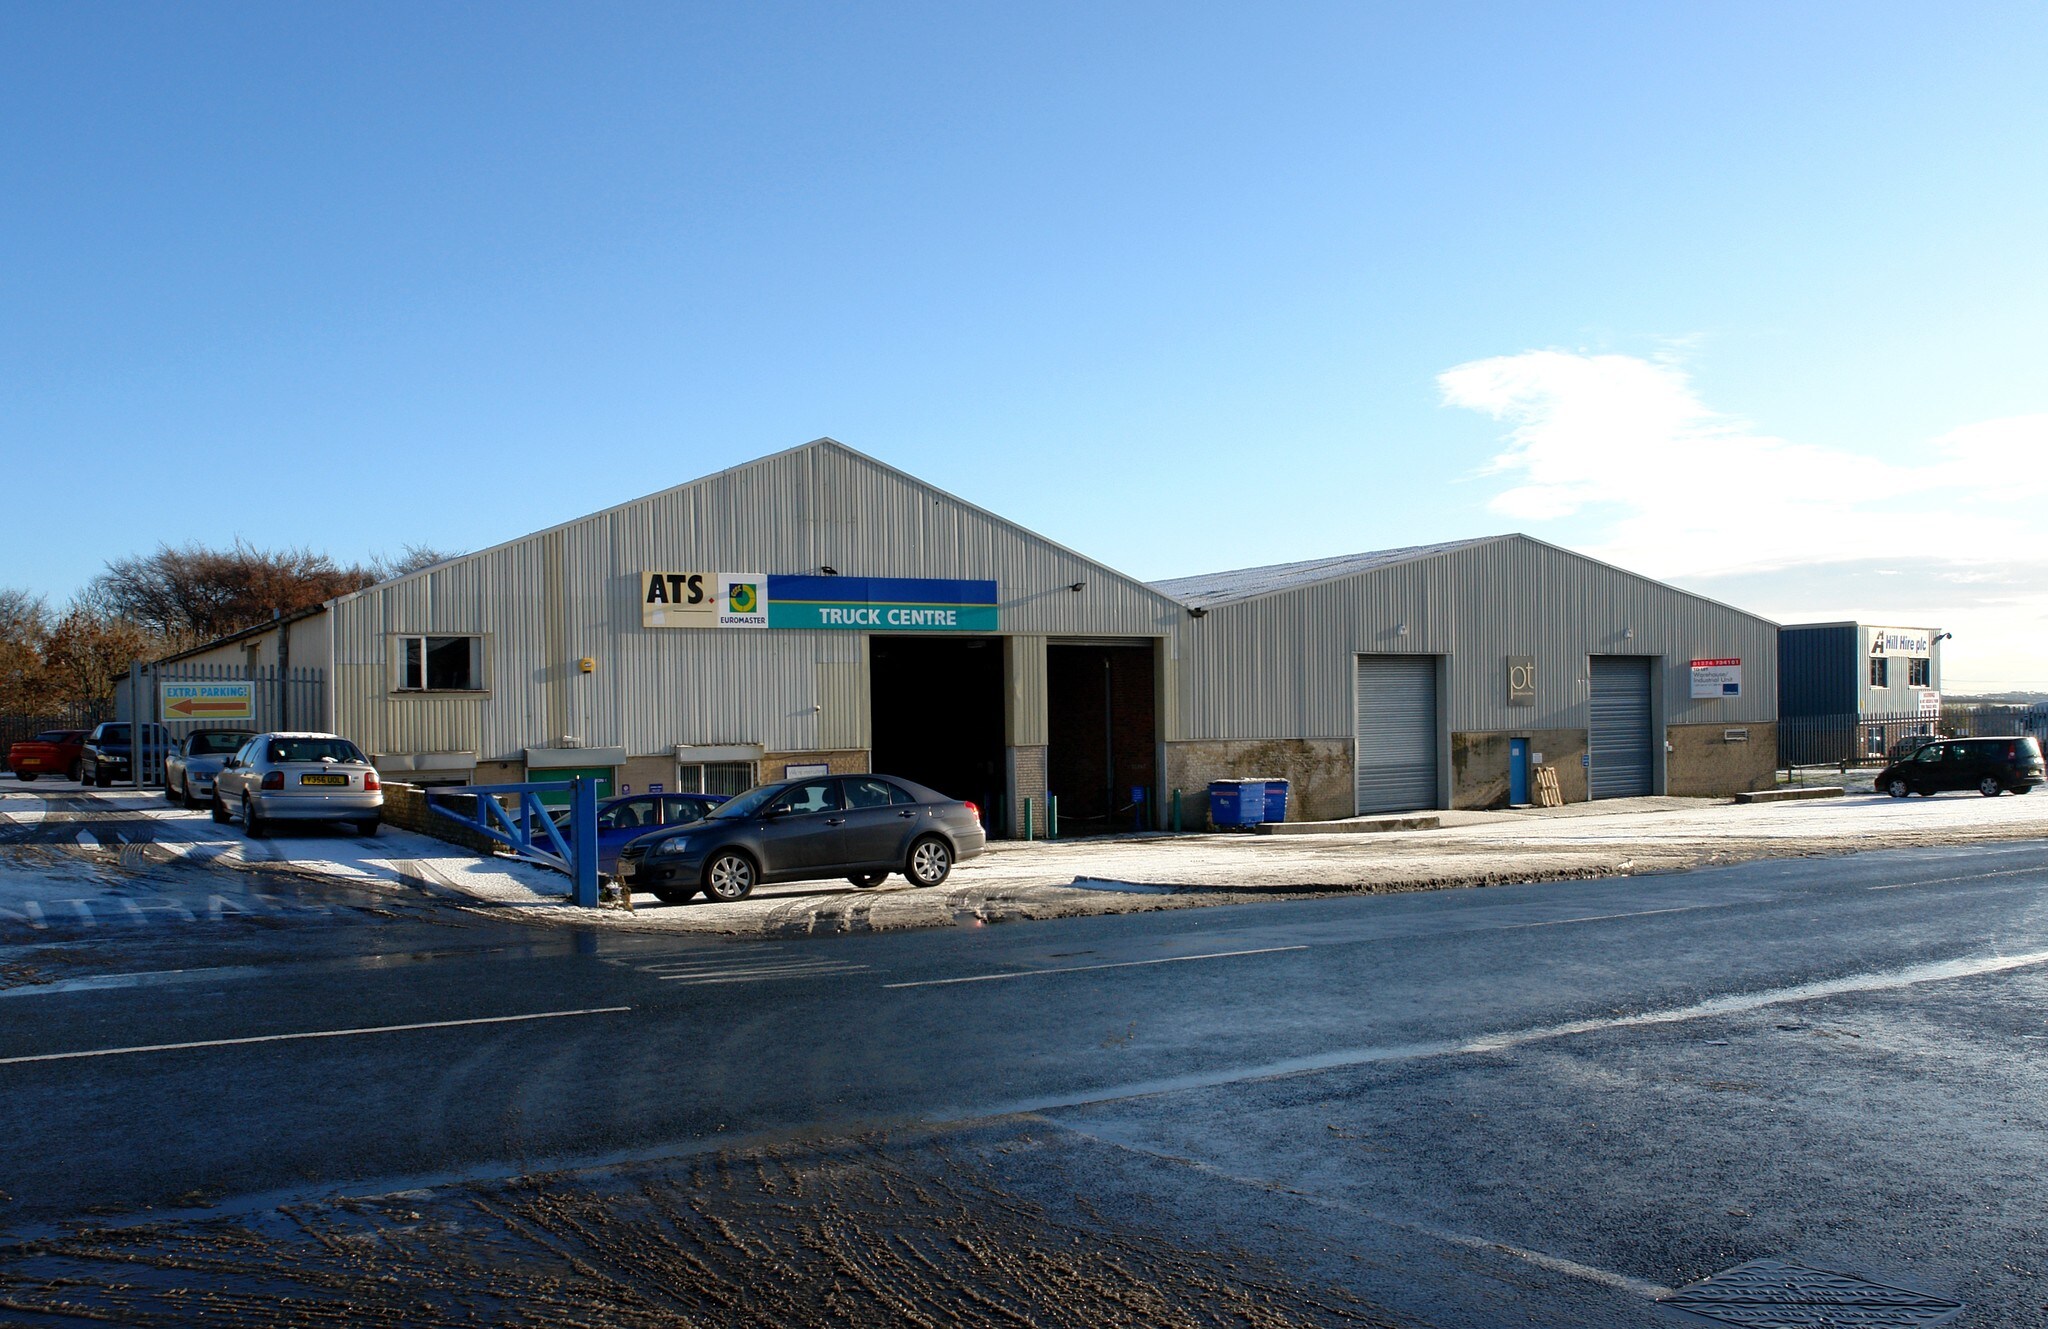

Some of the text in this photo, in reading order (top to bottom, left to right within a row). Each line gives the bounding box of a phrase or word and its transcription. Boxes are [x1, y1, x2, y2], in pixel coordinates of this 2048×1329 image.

[647, 574, 704, 604] ATS
[720, 616, 766, 624] EUROMASTER
[819, 608, 957, 626] TRUCK CENTRE
[1886, 634, 1927, 654] Hill Hire plc
[1511, 662, 1534, 700] pt
[167, 687, 247, 697] EXTRA PARKING!
